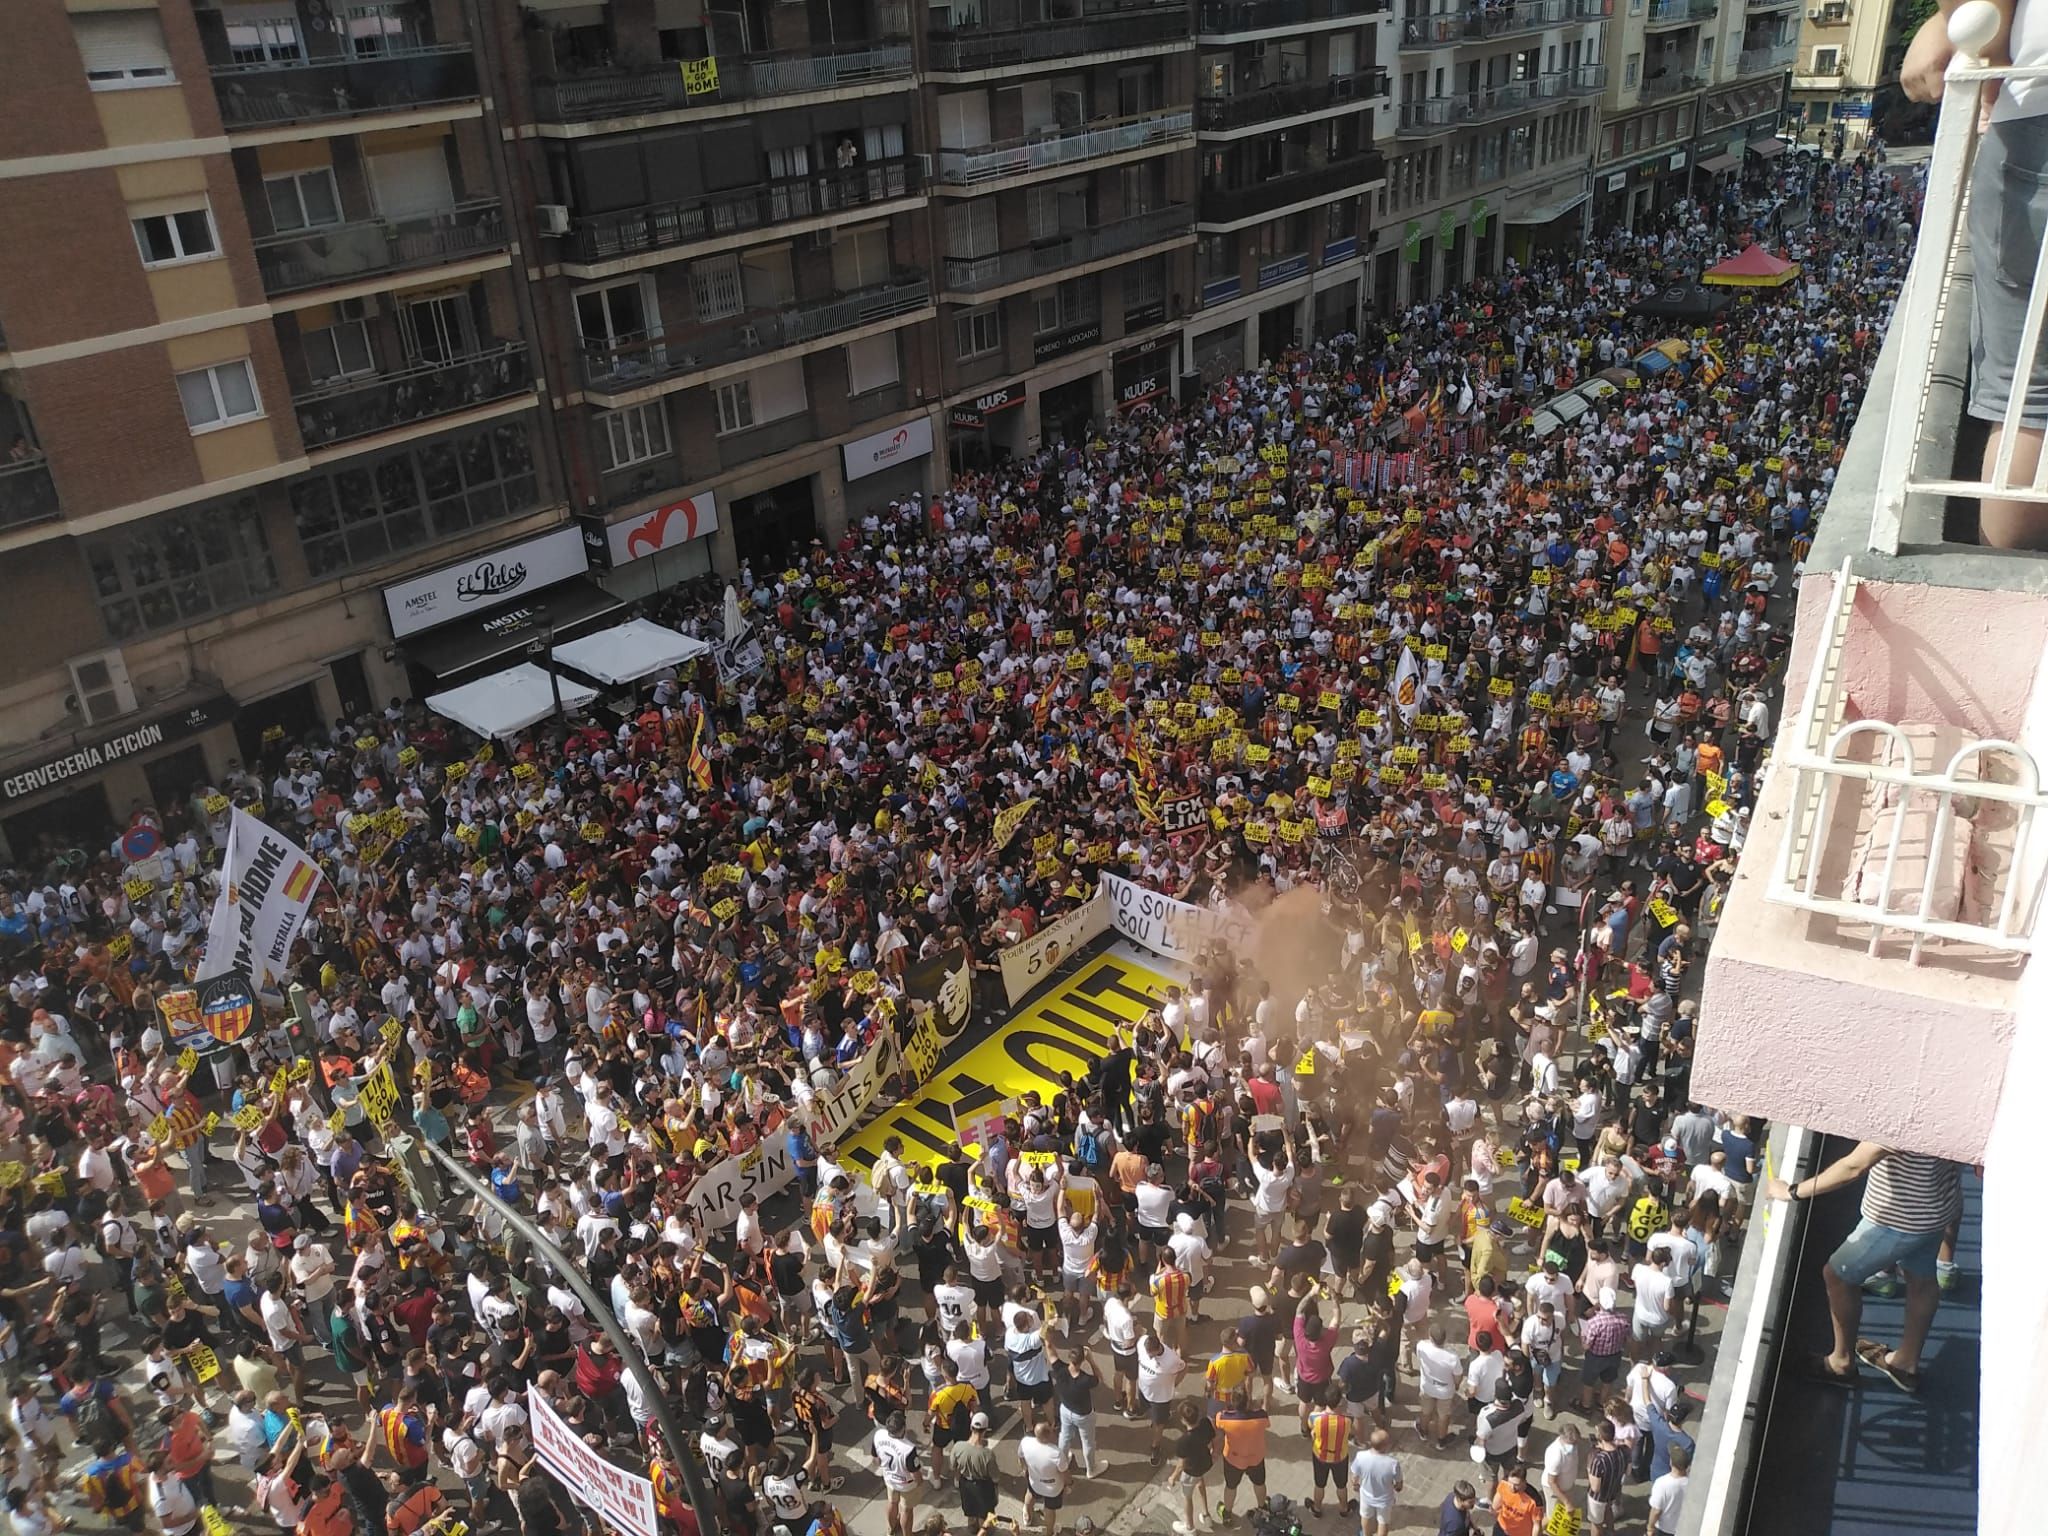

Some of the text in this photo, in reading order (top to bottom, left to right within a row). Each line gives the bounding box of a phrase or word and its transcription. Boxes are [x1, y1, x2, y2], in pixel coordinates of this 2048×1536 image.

[689, 60, 709, 73] LIM
[687, 77, 720, 92] HOME
[695, 72, 706, 81] GO
[1067, 328, 1099, 345] ASOCIADOS
[1124, 378, 1156, 400] KUUPS
[977, 390, 1008, 410] KUUPS
[954, 412, 979, 424] KUUPS
[1264, 444, 1284, 452] LIM
[405, 591, 438, 609] AMSTEL
[482, 607, 533, 632] AMSTEL
[3, 724, 163, 798] CERVECERÍA AFICIÓN
[1163, 797, 1205, 816] FCK
[1164, 809, 1207, 831] LIM
[1250, 824, 1264, 832] LIM
[1284, 822, 1297, 830] LIM
[238, 835, 288, 911] HOME
[1108, 878, 1132, 908] NO
[1139, 895, 1176, 924] SOU
[1118, 909, 1150, 941] SOU
[268, 912, 297, 963] MESTALLA
[1001, 945, 1025, 962] YOUR
[911, 1021, 929, 1052] LIM
[920, 1039, 932, 1056] GO
[366, 1068, 386, 1102] LIM
[376, 1088, 387, 1106] GO
[236, 1109, 249, 1121] LIM
[1509, 1212, 1544, 1228] HOME
[202, 1344, 216, 1368] LIM
[1549, 1503, 1566, 1534] HOME
